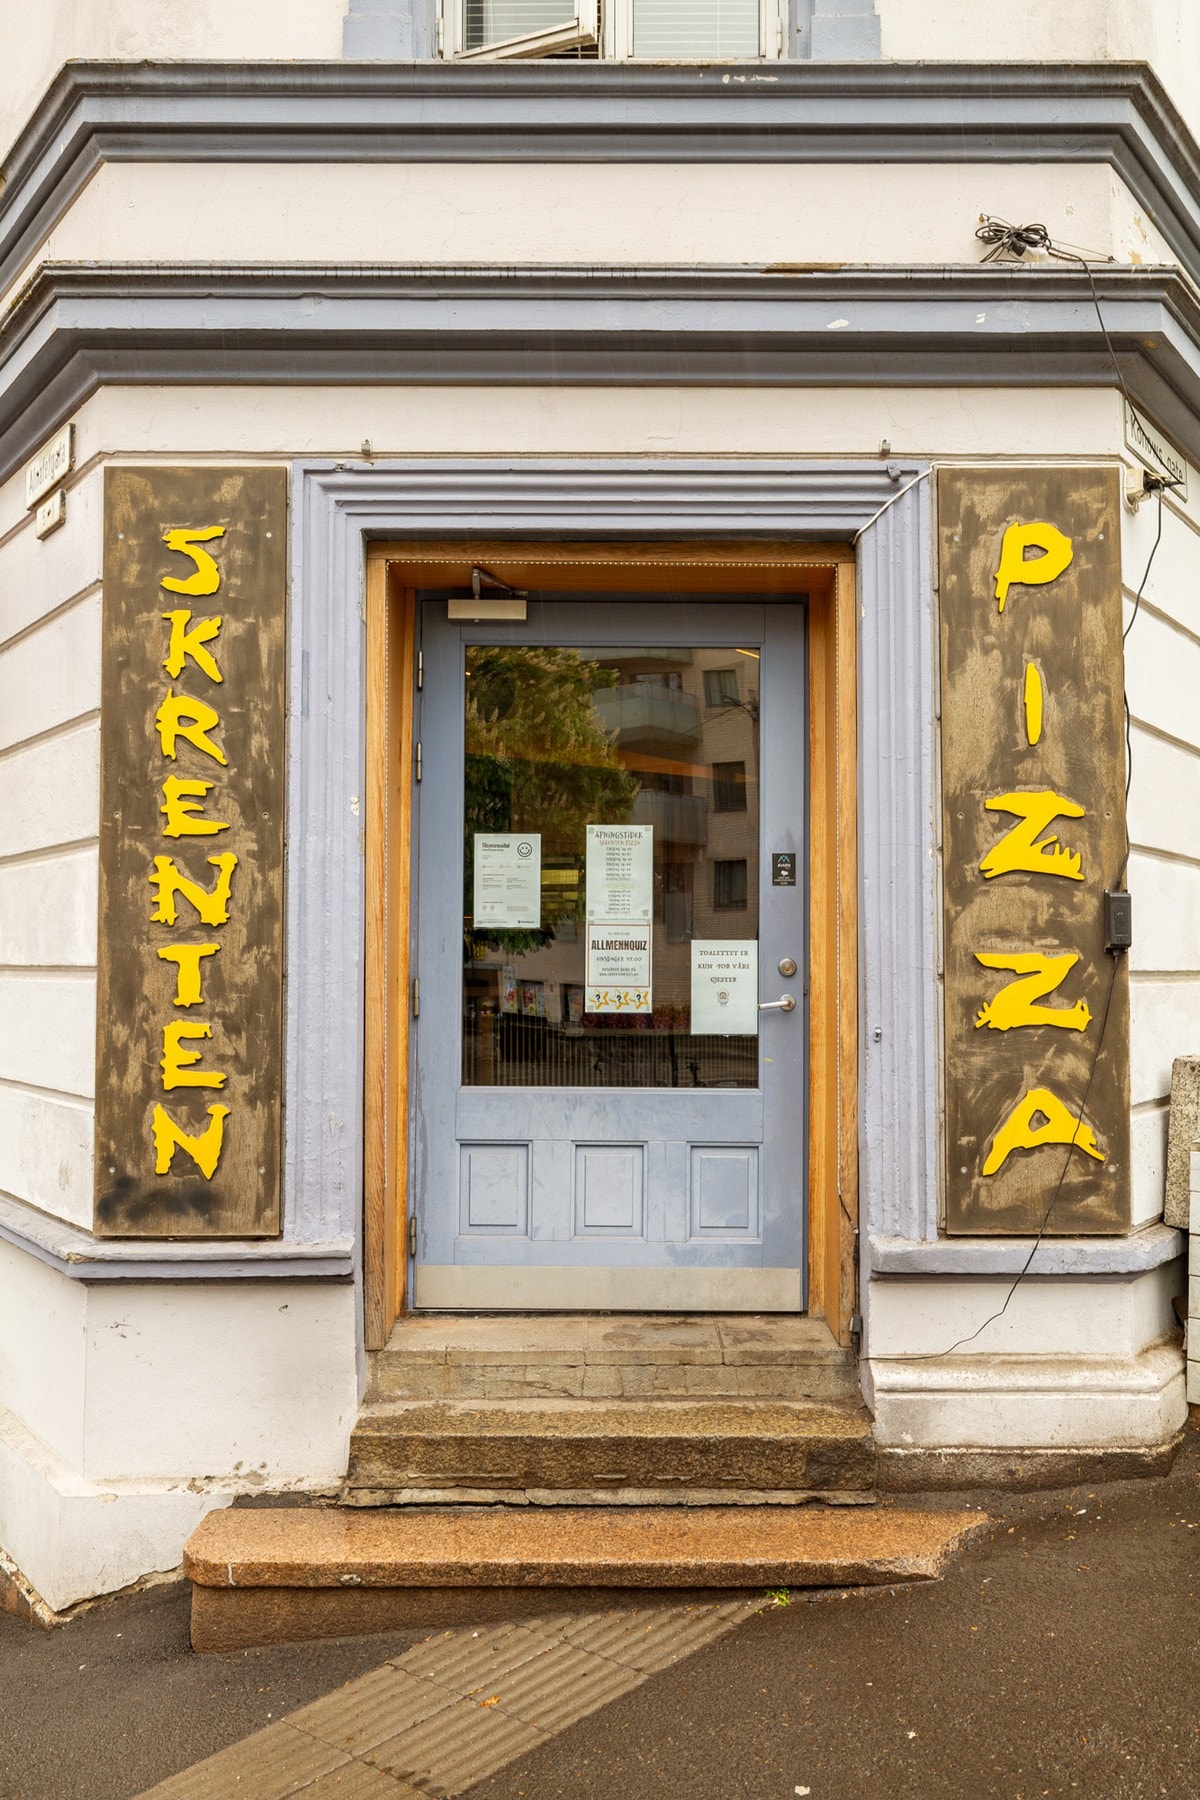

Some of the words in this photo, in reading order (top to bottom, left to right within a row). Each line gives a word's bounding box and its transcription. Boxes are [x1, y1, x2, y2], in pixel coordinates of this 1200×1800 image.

[28, 442, 66, 495] Alafetgata
[1130, 414, 1163, 465] Konows
[1167, 456, 1183, 479] gate
[149, 525, 238, 1180] SKRENTEN
[974, 522, 1105, 1176] PIZZA
[591, 940, 648, 951] ALLMENNQUIZ
[595, 993, 601, 1003] ?
[616, 994, 622, 1004] ?
[636, 993, 642, 1003] ?
[710, 976, 738, 984] GJESTER
